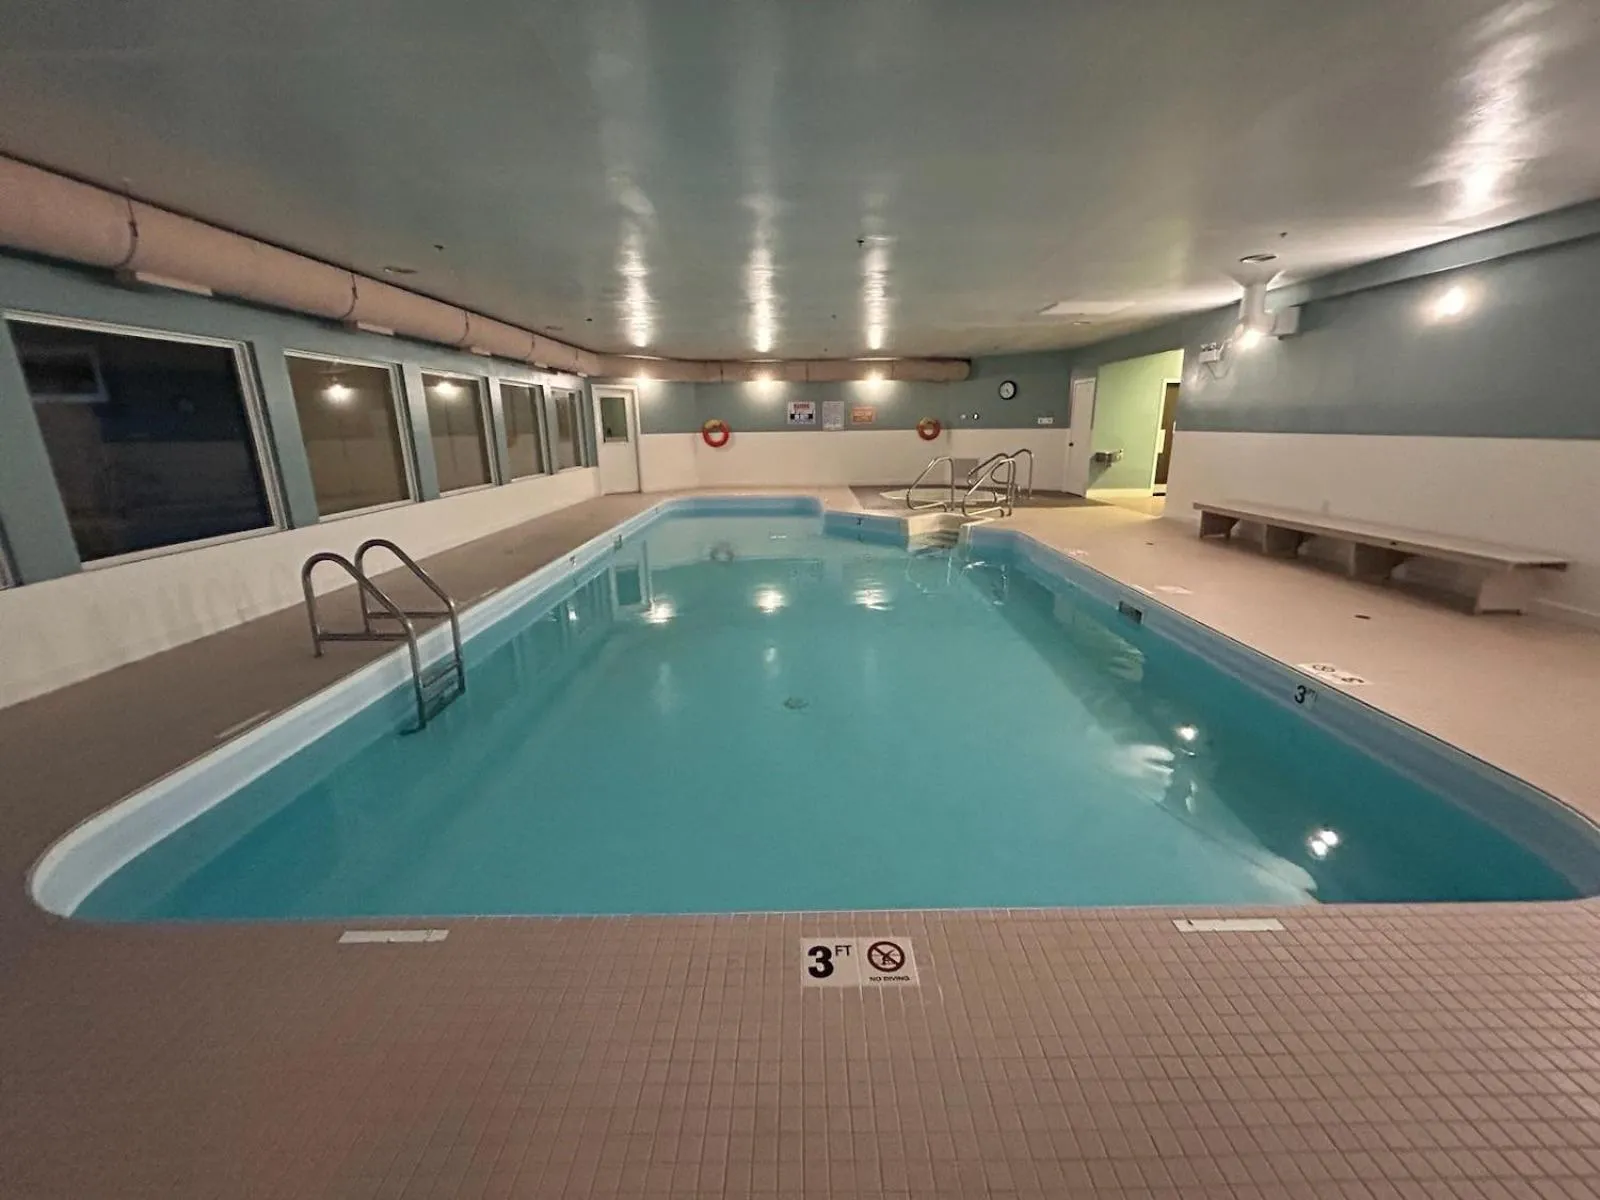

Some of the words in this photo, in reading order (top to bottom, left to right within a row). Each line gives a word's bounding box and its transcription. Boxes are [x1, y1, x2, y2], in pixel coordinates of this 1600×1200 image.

[1294, 685, 1306, 704] 3
[808, 945, 834, 978] 3
[835, 945, 852, 956] FT
